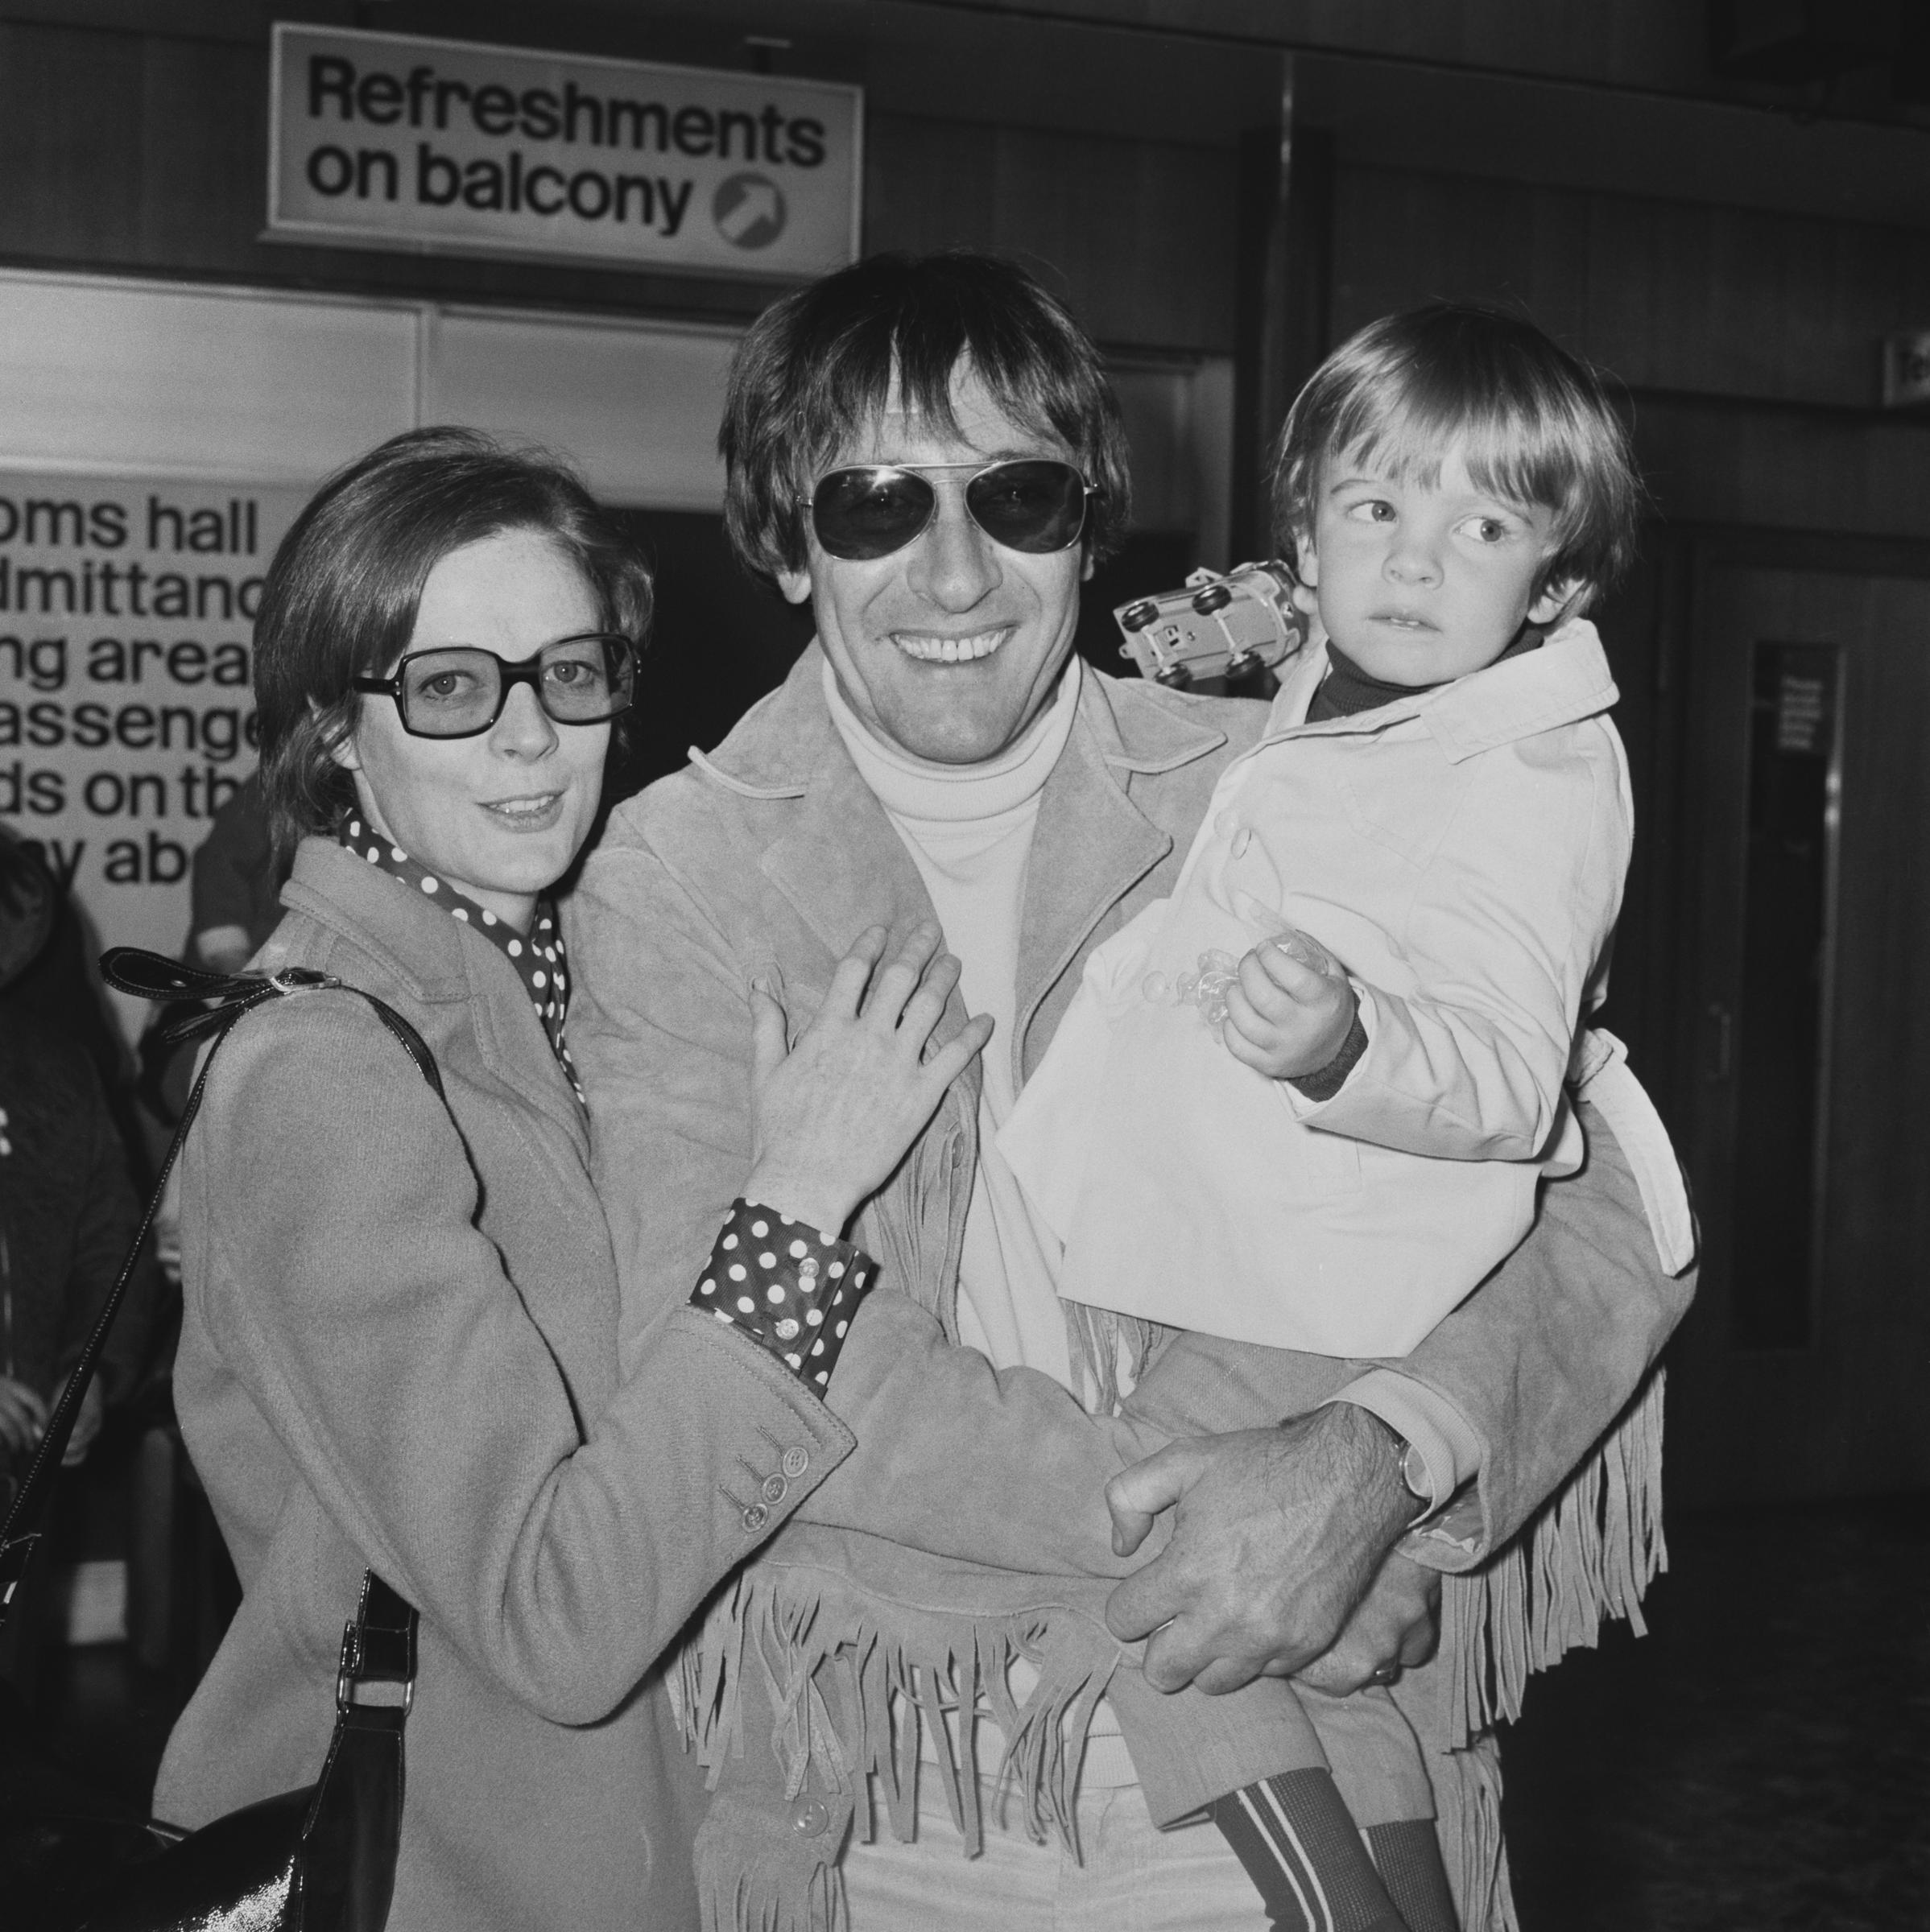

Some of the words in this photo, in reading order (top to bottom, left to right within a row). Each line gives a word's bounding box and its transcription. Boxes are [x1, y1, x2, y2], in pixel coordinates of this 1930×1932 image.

[308, 54, 826, 168] Refreshments
[307, 145, 399, 201] on
[417, 143, 693, 237] balcony
[149, 495, 256, 555] hall
[0, 557, 266, 620] mittanc
[0, 637, 66, 691] ng
[88, 639, 248, 686] area
[85, 771, 166, 818] on
[105, 832, 187, 884] ab
